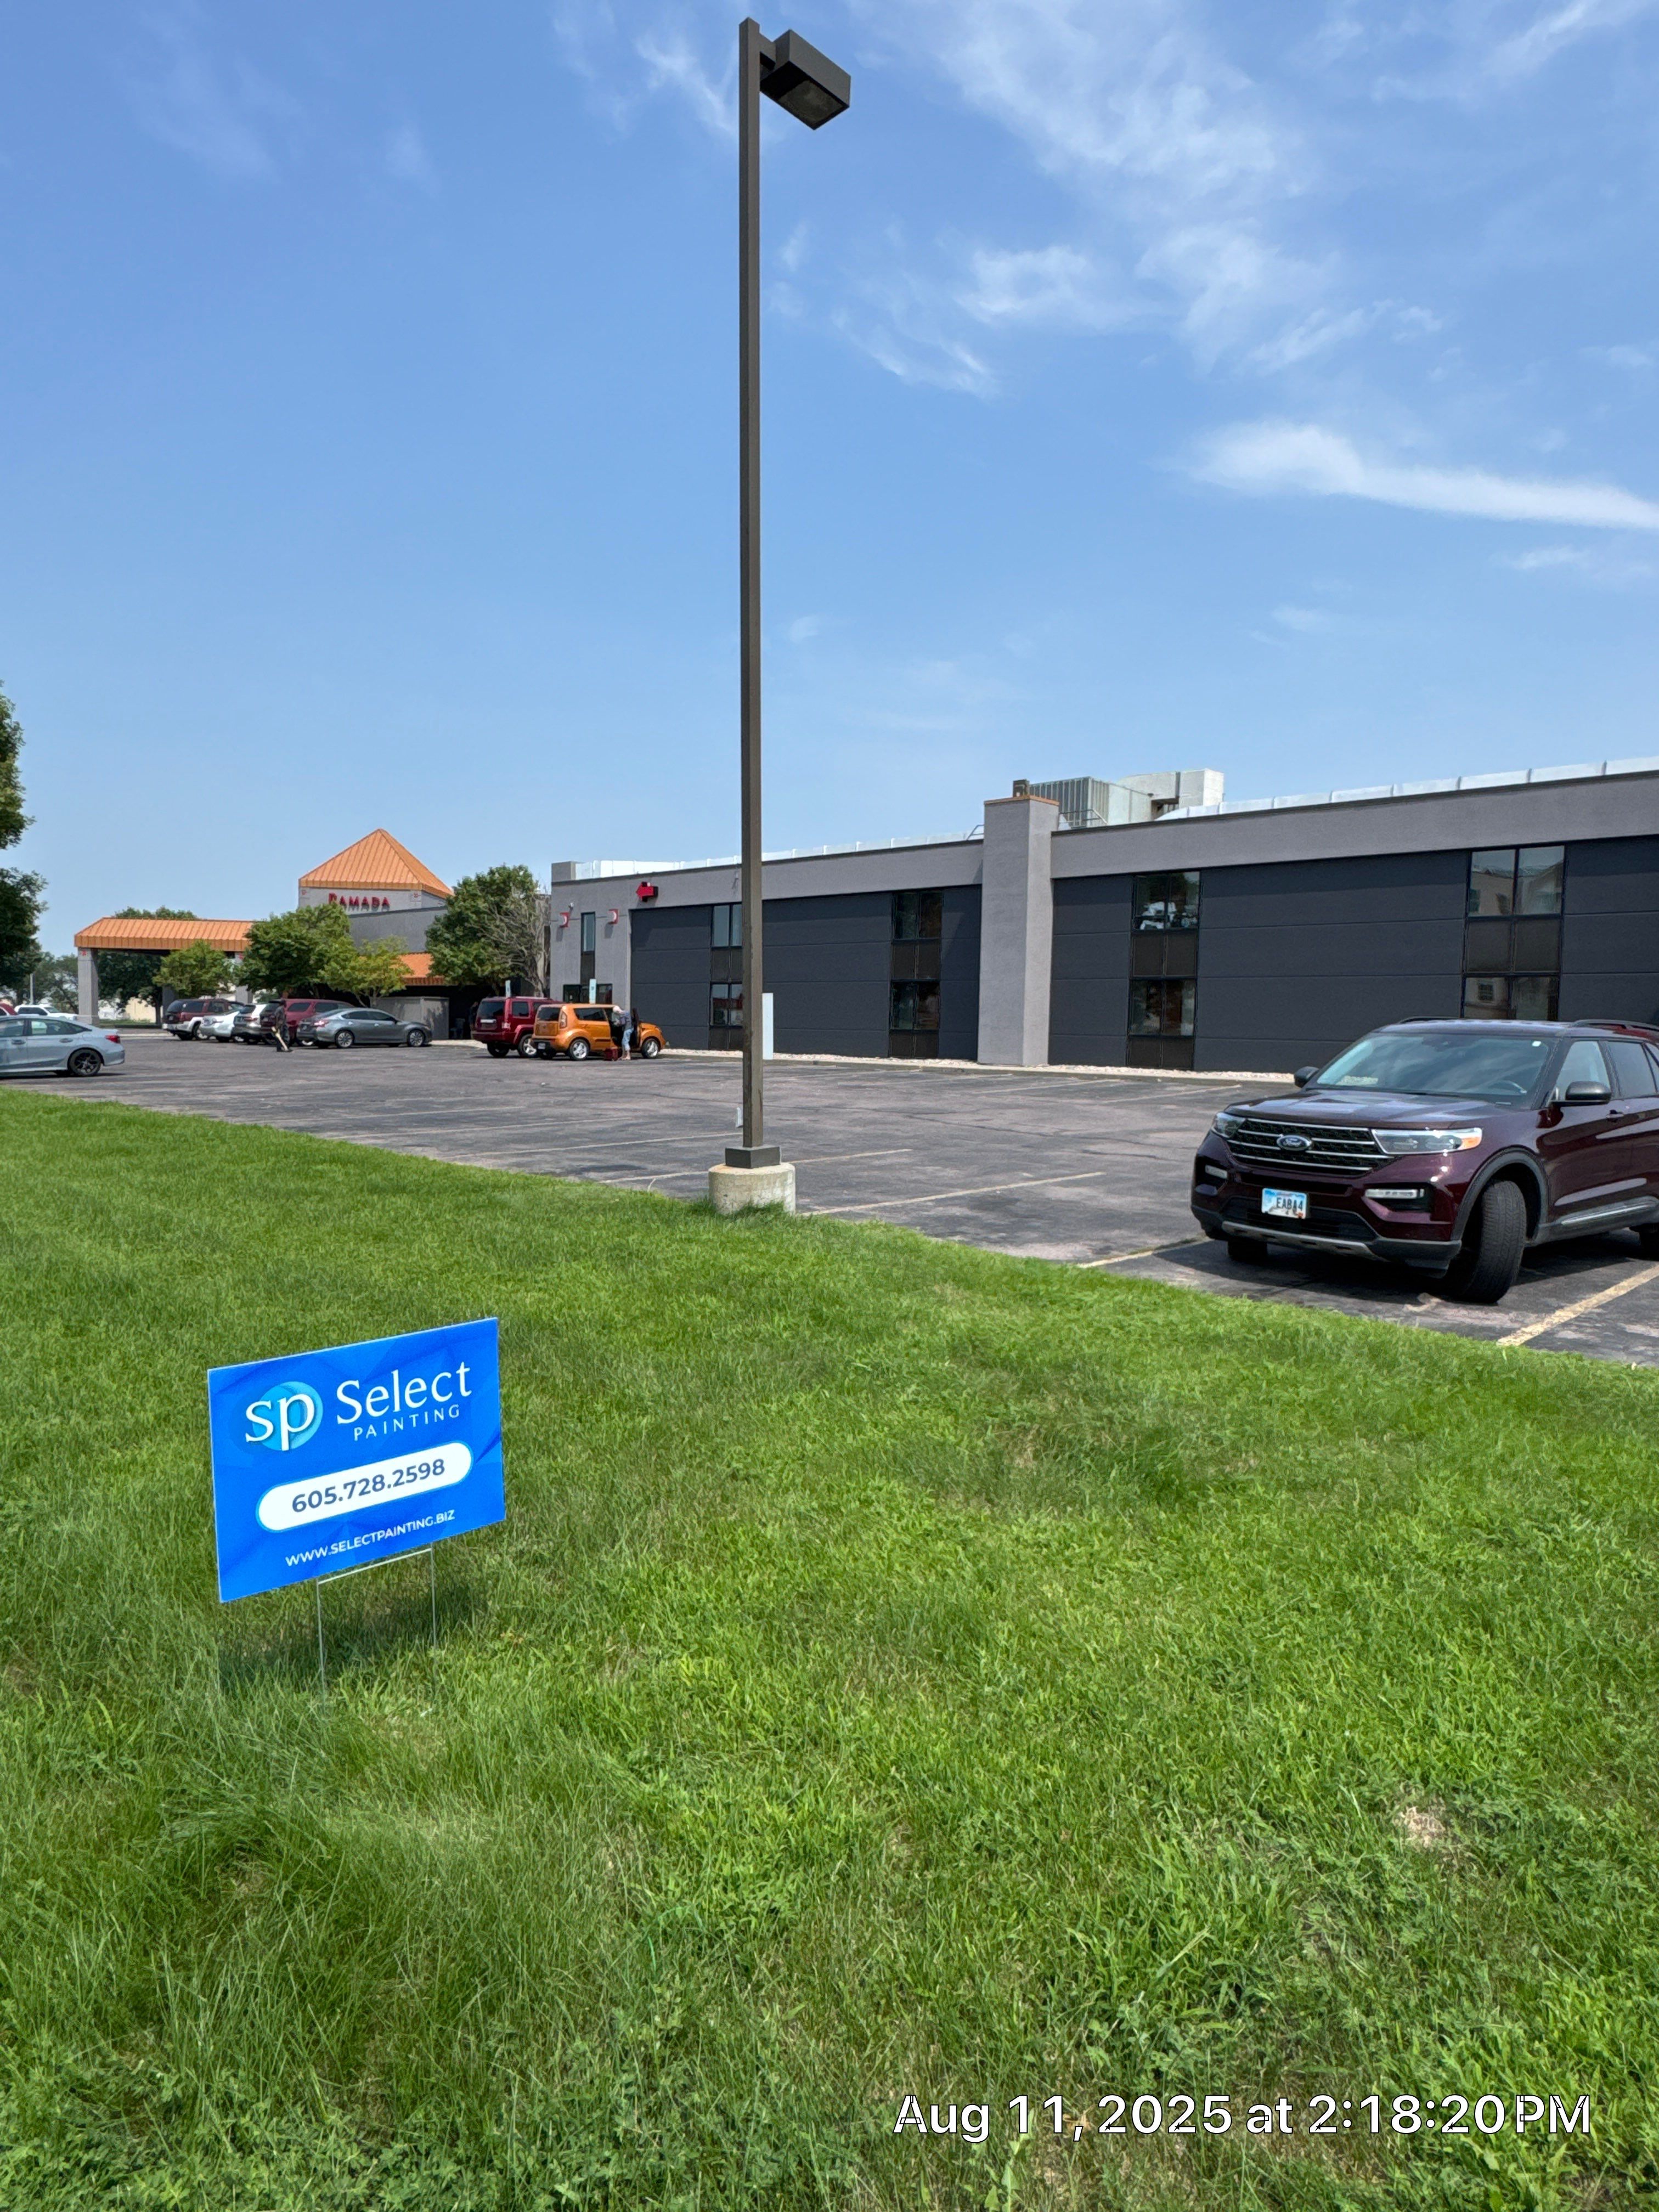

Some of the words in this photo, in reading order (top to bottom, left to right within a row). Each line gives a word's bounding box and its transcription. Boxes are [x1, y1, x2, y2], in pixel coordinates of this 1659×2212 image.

[336, 1362, 472, 1424] Select
[353, 1404, 460, 1441] PAINTING
[291, 1458, 446, 1513] 605.728.2598
[285, 1510, 455, 1567] WWW.SELECTPAINTING.BIZ
